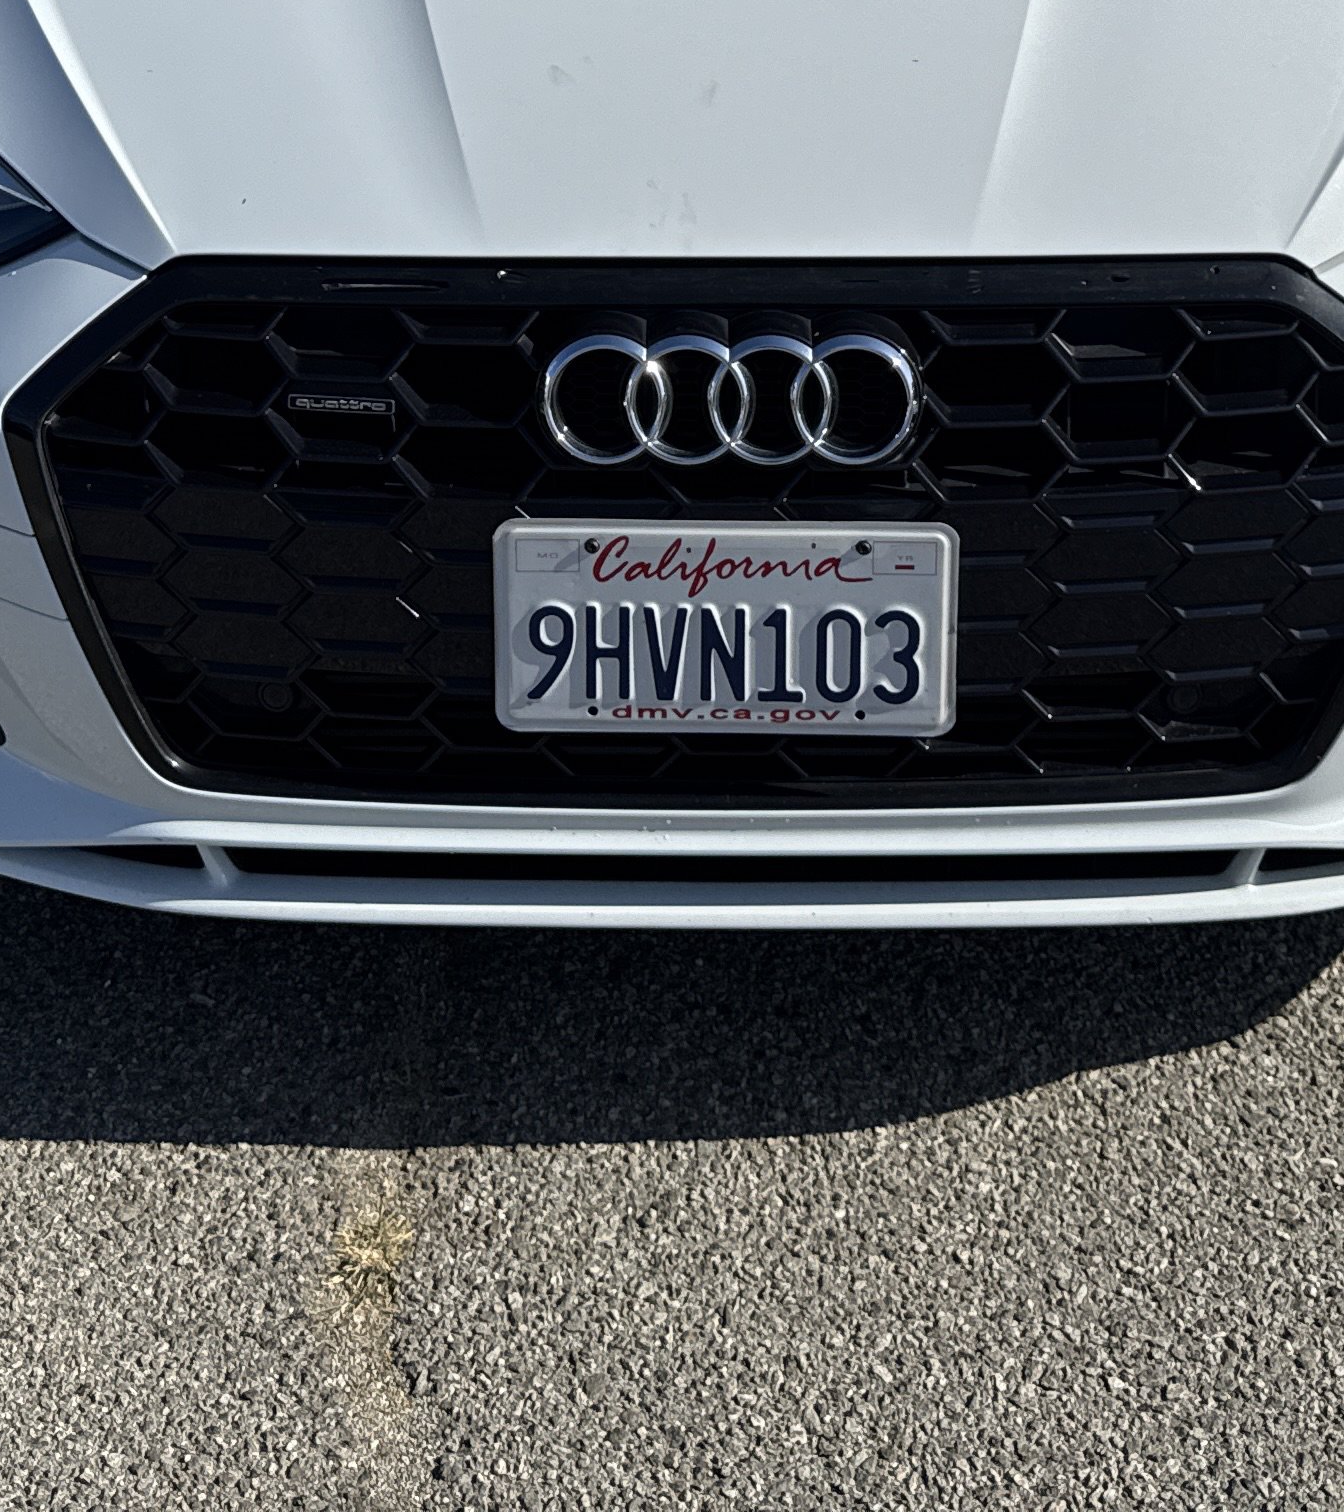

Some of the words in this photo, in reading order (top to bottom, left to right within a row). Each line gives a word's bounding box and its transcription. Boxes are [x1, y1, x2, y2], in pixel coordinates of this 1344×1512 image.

[295, 398, 386, 411] quattro
[592, 535, 874, 598] California
[527, 604, 922, 704] 9HVN103
[612, 703, 842, 723] dmv.ca.gov
